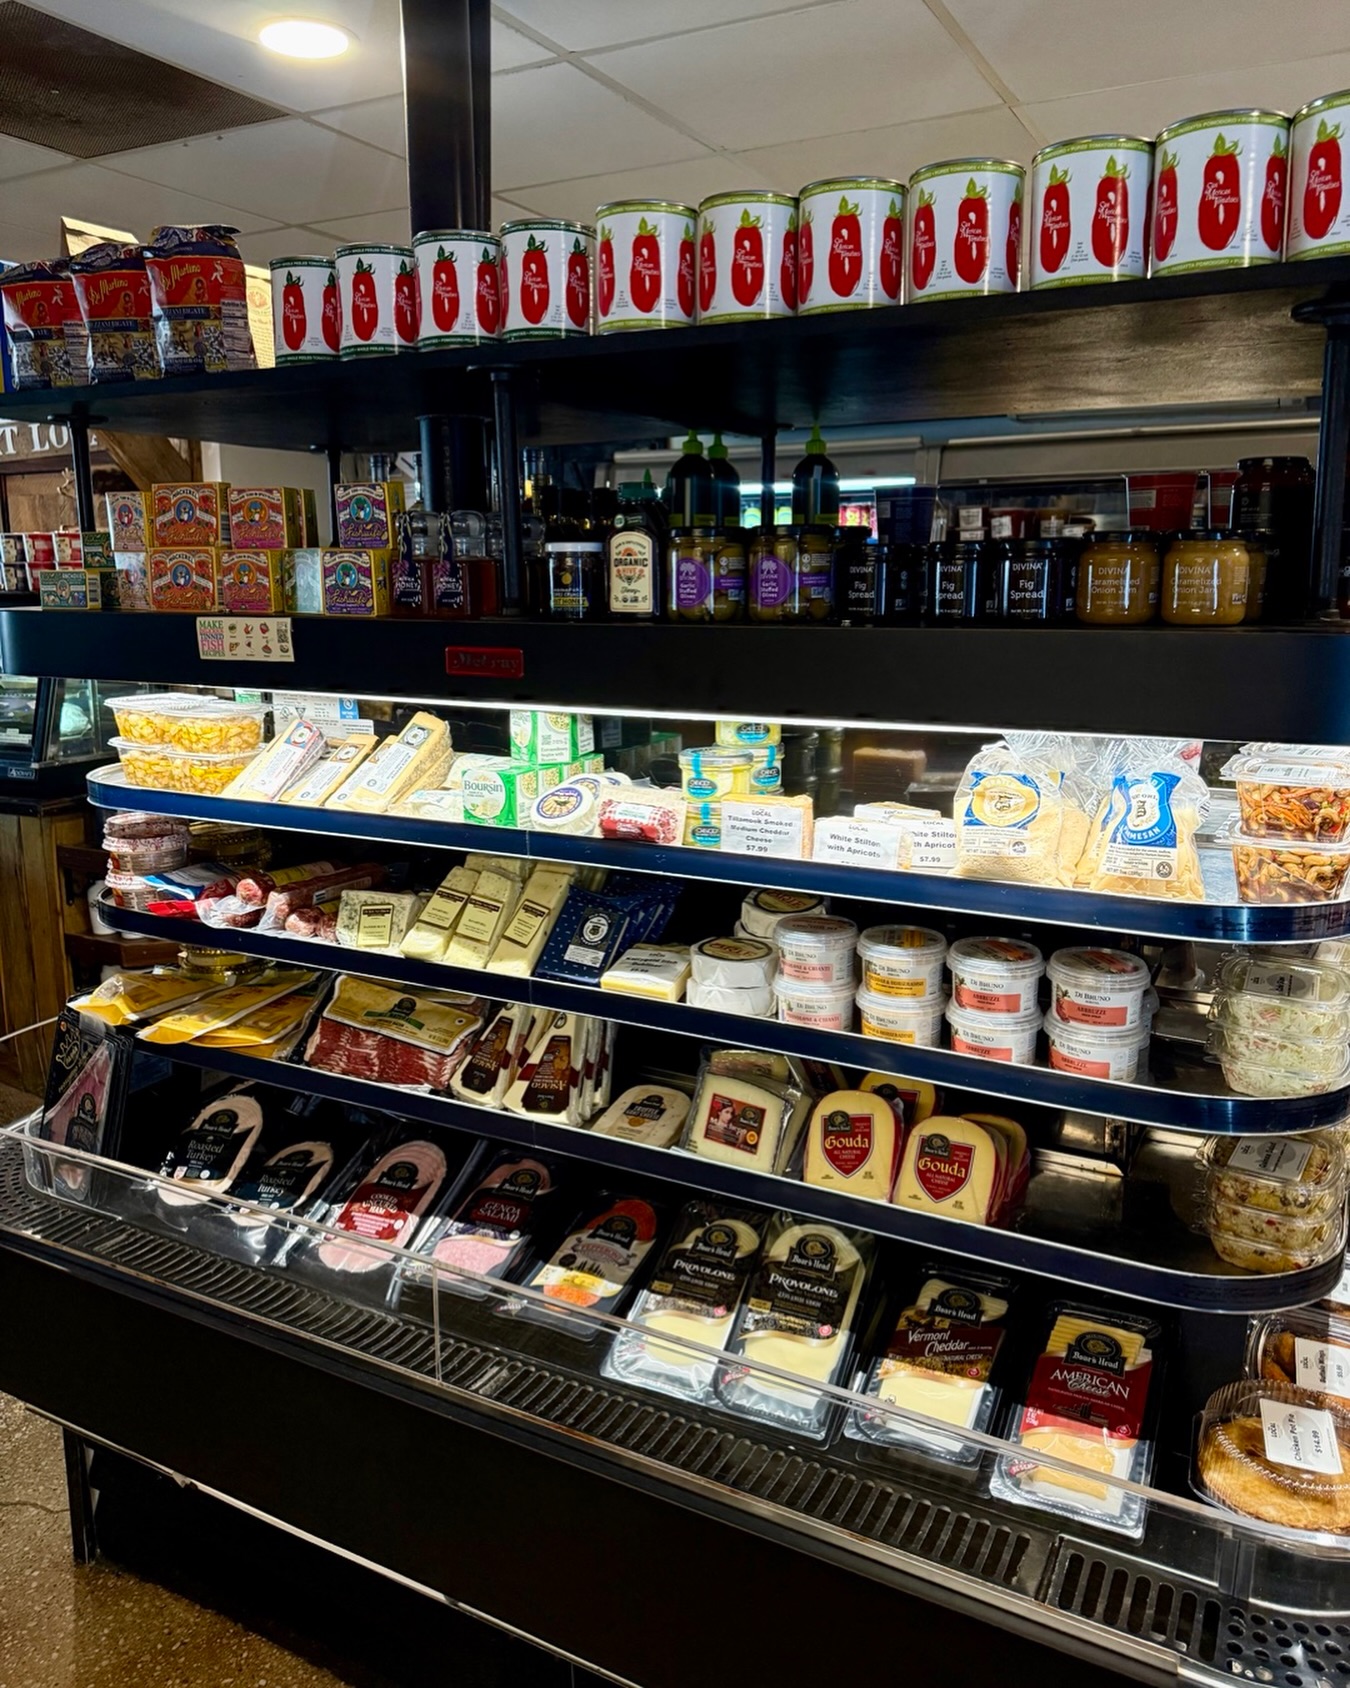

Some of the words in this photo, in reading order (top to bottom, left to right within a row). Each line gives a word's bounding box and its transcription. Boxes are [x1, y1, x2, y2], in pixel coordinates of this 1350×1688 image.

[613, 558, 649, 567] ORGANIC
[1012, 562, 1043, 571] DIVINA
[854, 581, 867, 592] Fig
[941, 580, 955, 593] Fig
[1019, 579, 1035, 591] Fig
[848, 590, 875, 600] Spread
[1010, 590, 1045, 601] Spread
[199, 620, 224, 630] MAKE
[200, 633, 225, 641] TINNED
[201, 640, 225, 651] FISH
[202, 650, 226, 658] RECIPES
[752, 809, 772, 818] LOCAL
[764, 818, 793, 828] Smoked
[730, 825, 758, 833] Medium
[759, 827, 790, 836] Cheddar
[746, 835, 773, 844] Cheese
[829, 833, 853, 843] White
[854, 837, 881, 847] Stilton
[746, 845, 769, 853] $7.99
[827, 843, 845, 852] with
[846, 846, 881, 859] Apricots
[796, 952, 817, 960] BRUNO
[979, 981, 1004, 989] BRUNO
[1084, 992, 1111, 1001] BRUNO
[876, 1016, 898, 1025] BRUNO
[971, 1033, 994, 1042] BRUNO
[1068, 1045, 1091, 1055] BRUNO
[531, 1077, 567, 1092] ASIAGO
[187, 1138, 225, 1155] Roasted
[824, 1133, 870, 1149] Gouda
[185, 1150, 217, 1165] Turkey
[918, 1157, 966, 1178] Gouda
[259, 1173, 297, 1187] Roasted
[257, 1184, 285, 1198] Turkey
[478, 1206, 520, 1223] SALAMI
[485, 1201, 521, 1217] GENOA
[673, 1258, 736, 1282] PROVOLONE
[812, 1259, 832, 1272] Head
[768, 1272, 839, 1299] PROVOLONE
[934, 1303, 957, 1316] Boar's
[957, 1308, 977, 1321] Head
[907, 1329, 952, 1345] Vermont
[923, 1339, 970, 1358] Cheddar
[1072, 1350, 1097, 1364] Boar's
[1097, 1355, 1120, 1369] Head
[1050, 1368, 1132, 1400] AMERICAN
[1067, 1379, 1111, 1397] Cheese
[1269, 1422, 1277, 1438] LOCAL
[1289, 1424, 1297, 1435] Pot
[1291, 1435, 1302, 1461] Chicken
[1311, 1430, 1323, 1453] $14.99
